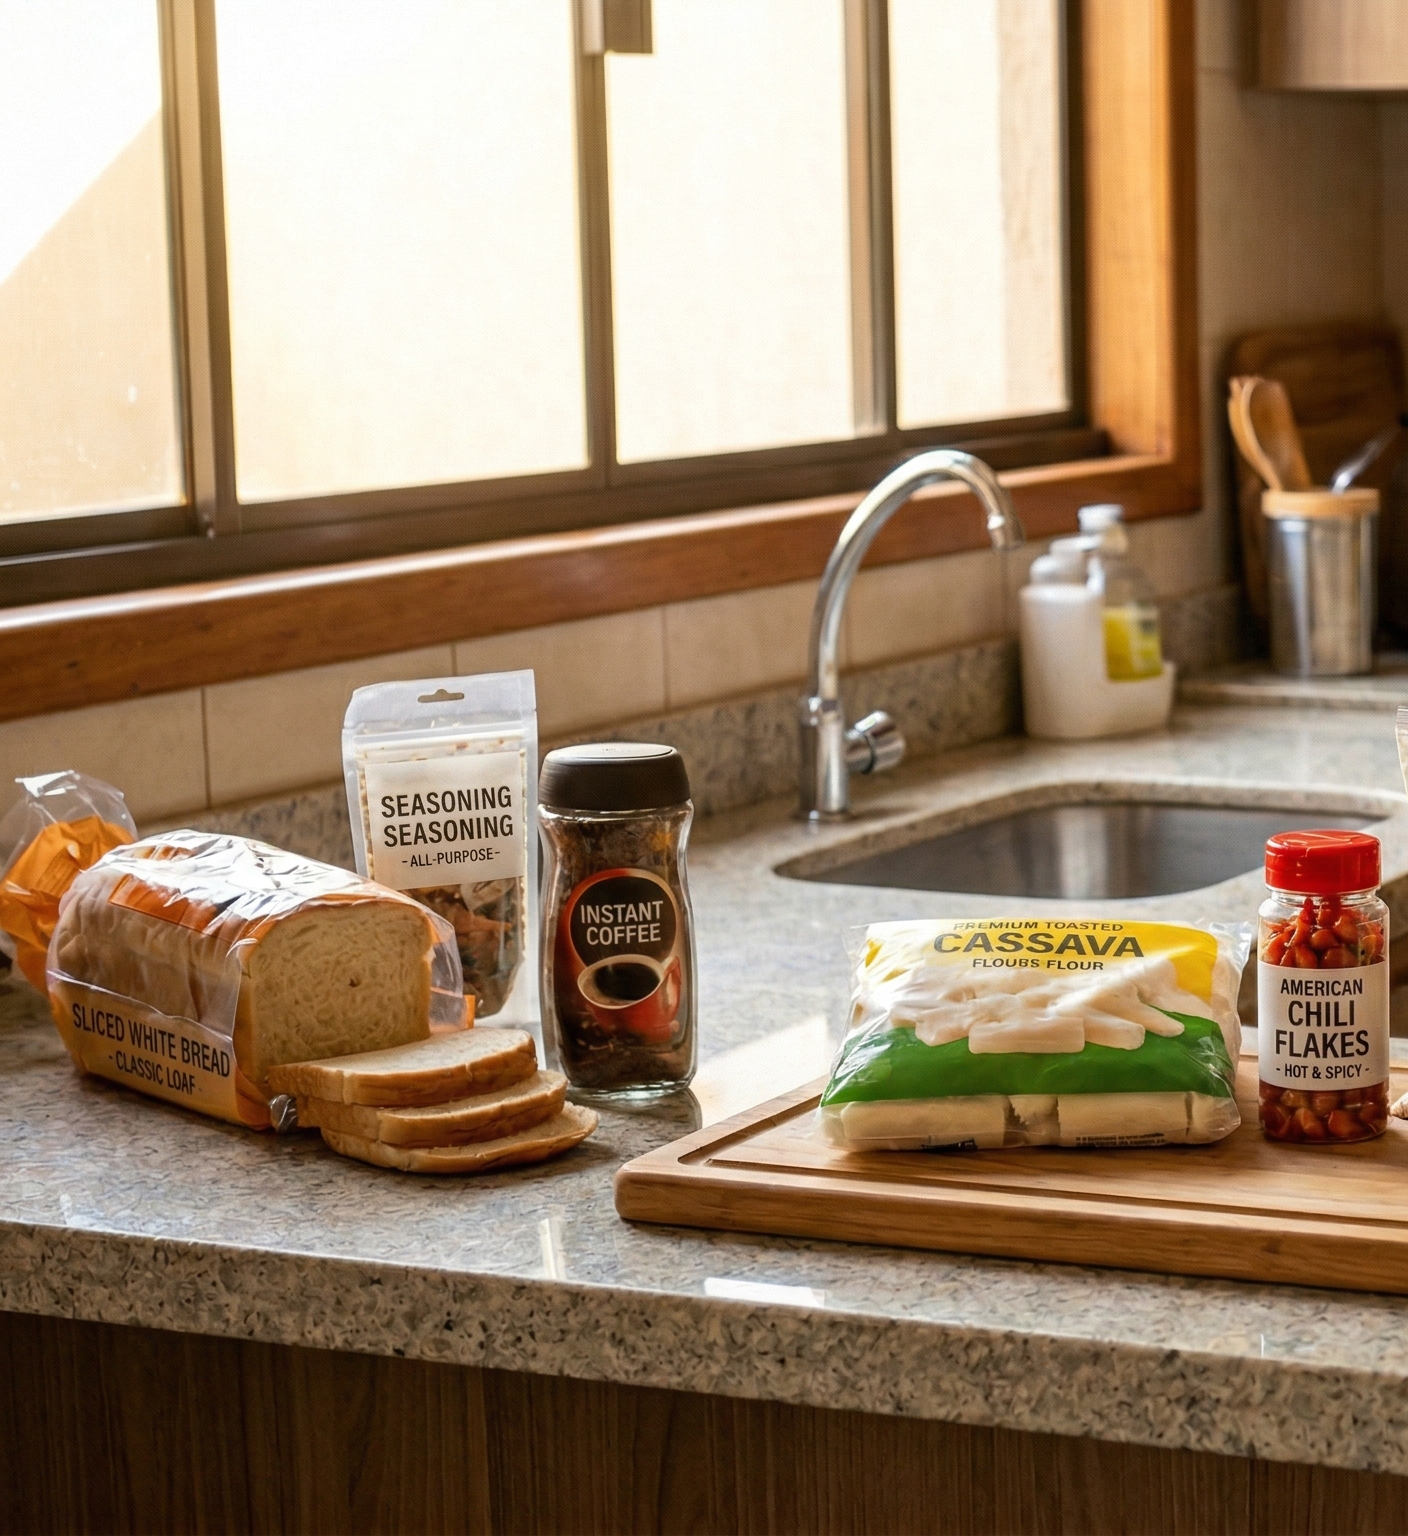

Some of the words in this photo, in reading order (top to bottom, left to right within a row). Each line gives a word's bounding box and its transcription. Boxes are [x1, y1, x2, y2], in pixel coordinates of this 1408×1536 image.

[381, 785, 512, 819] SEASONING
[383, 814, 514, 848] SEASONING
[580, 900, 664, 924] INSTANT
[586, 922, 662, 946] COFFEE
[953, 921, 1039, 930] PREMIUM
[1044, 921, 1124, 932] TOASTED
[933, 932, 1145, 958] CASSAVA
[1046, 959, 1104, 971] FLOUR
[1280, 978, 1363, 997] AMERICAN
[1288, 1000, 1355, 1027] CHILI
[72, 1002, 125, 1042] SLICED
[128, 1019, 178, 1061] WHITE
[181, 1036, 230, 1078] BREAD
[1275, 1028, 1370, 1059] FLAKES
[115, 1050, 164, 1085] CLASSIC
[166, 1066, 196, 1095] LOAF
[1284, 1063, 1309, 1079] HOT
[1311, 1065, 1322, 1080] &
[1325, 1063, 1363, 1079] SPICY
